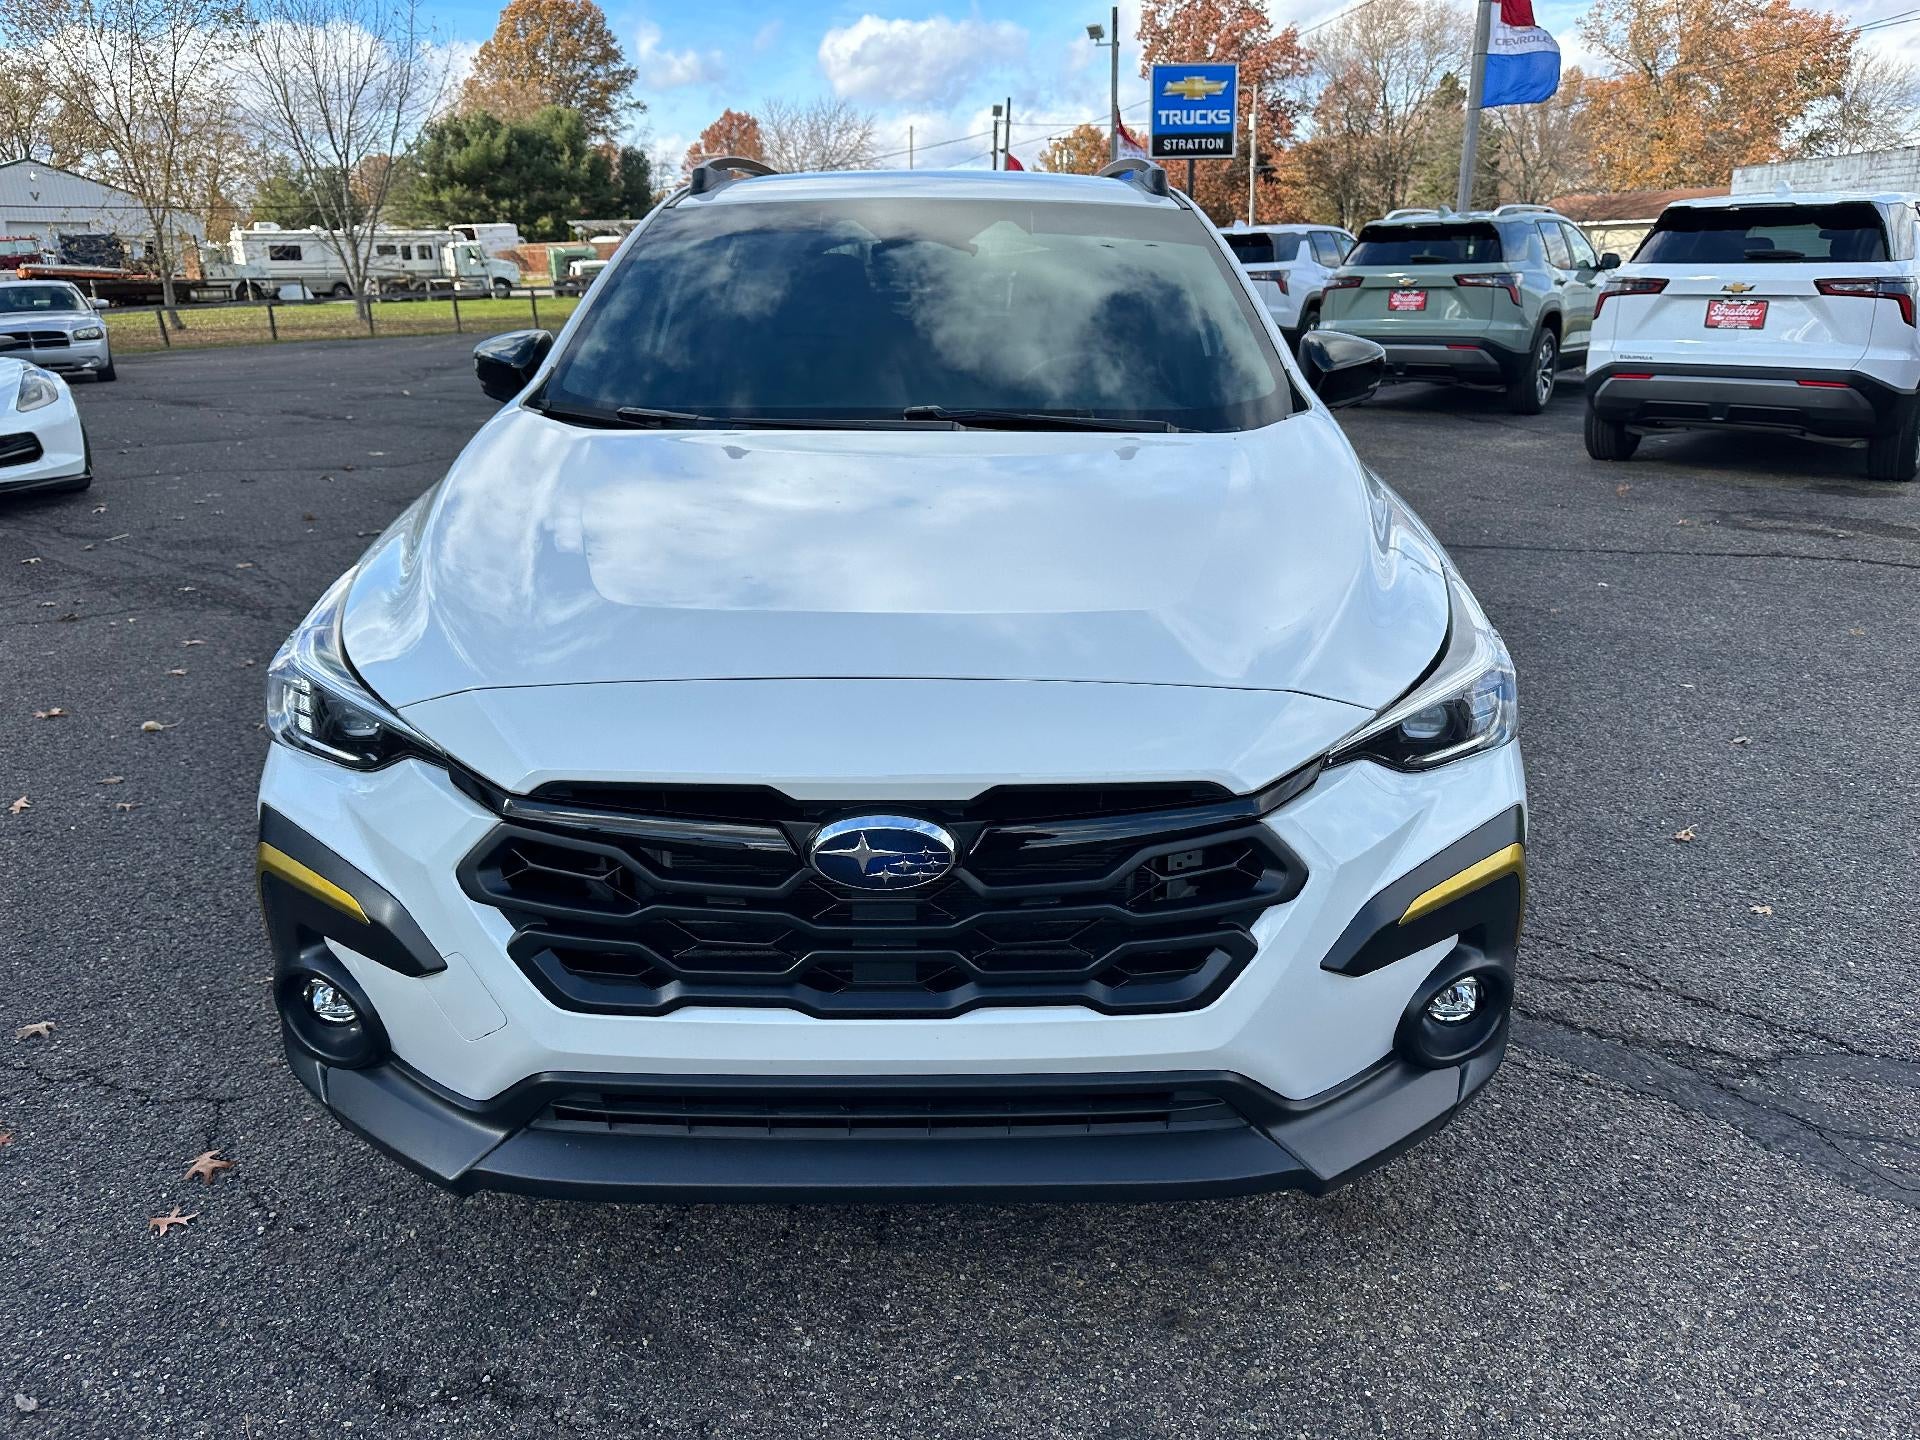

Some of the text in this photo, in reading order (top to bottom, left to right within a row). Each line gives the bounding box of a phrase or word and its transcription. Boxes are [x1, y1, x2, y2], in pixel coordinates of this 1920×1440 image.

[1495, 35, 1555, 46] CEVROLE
[1158, 109, 1231, 125] TRUCKS
[1163, 138, 1224, 150] STRATTON
[1710, 303, 1763, 316] Stratton
